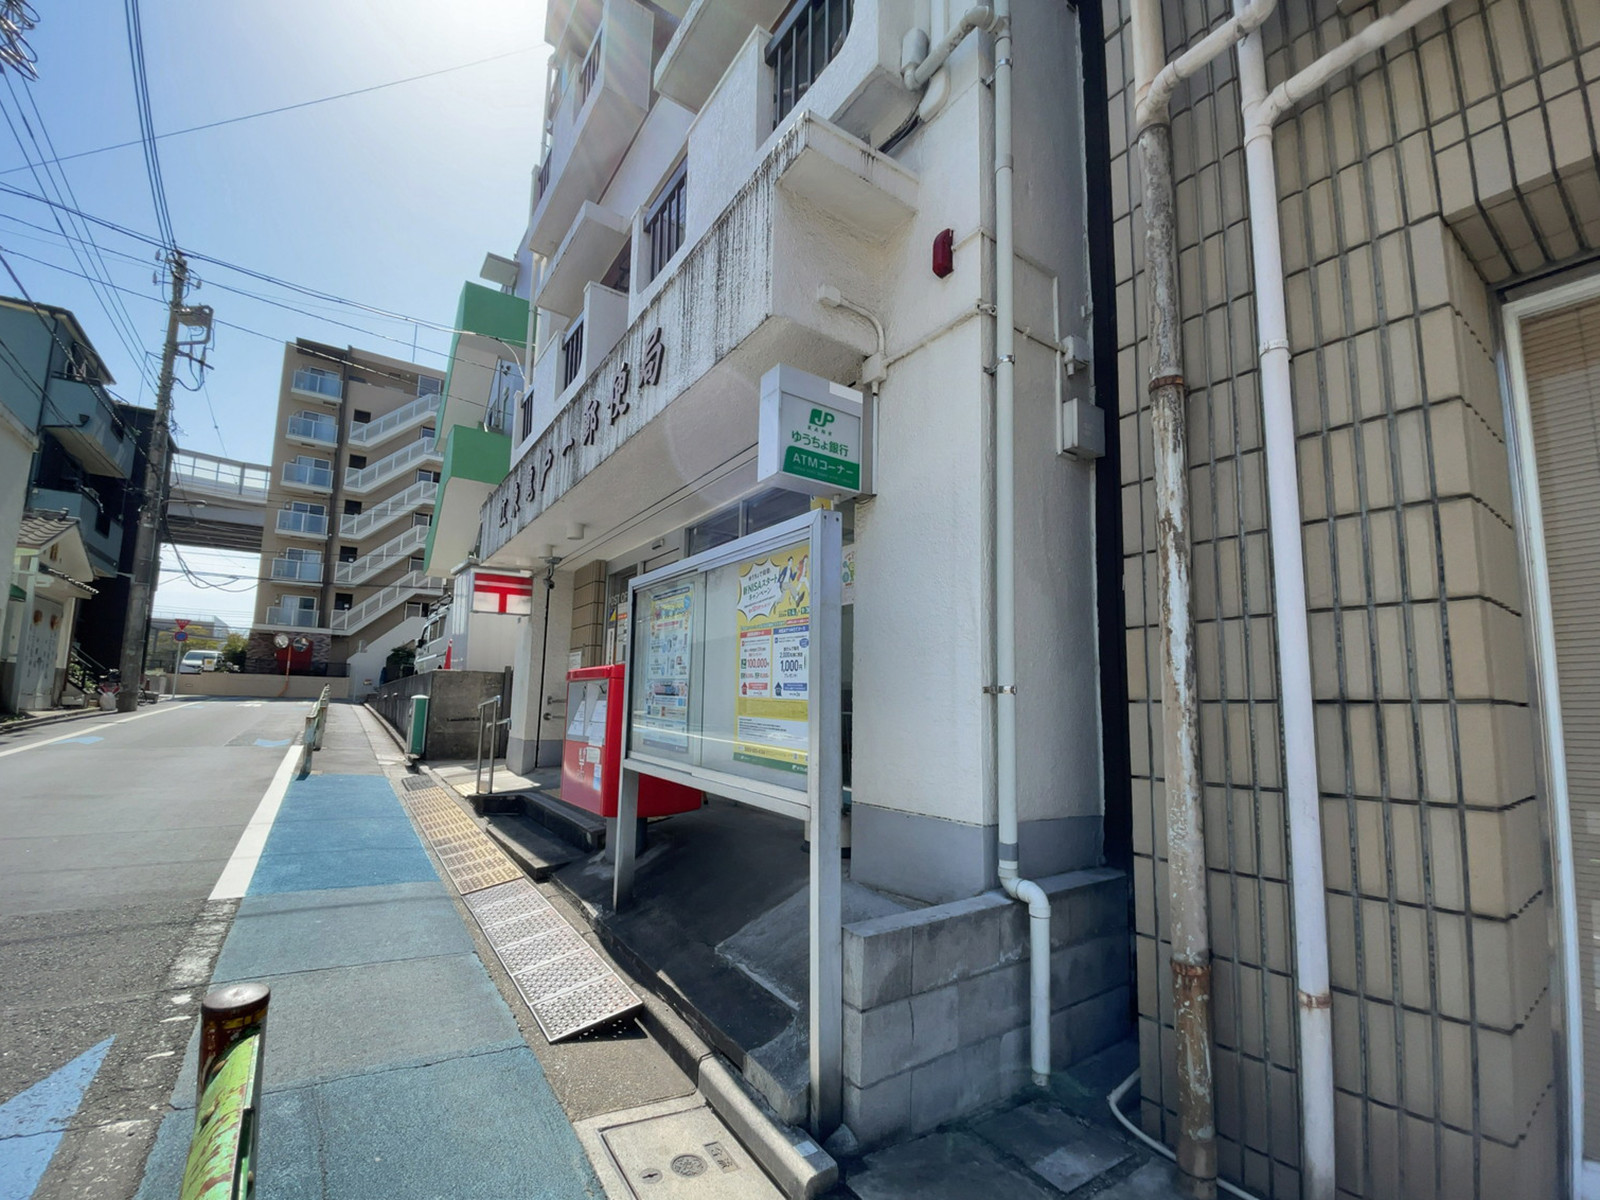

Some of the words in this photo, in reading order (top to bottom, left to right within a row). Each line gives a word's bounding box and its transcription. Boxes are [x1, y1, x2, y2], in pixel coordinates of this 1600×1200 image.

[809, 408, 835, 427] JP
[791, 430, 849, 457] ゆうちょ銀行
[792, 452, 854, 475] ATMコーナー
